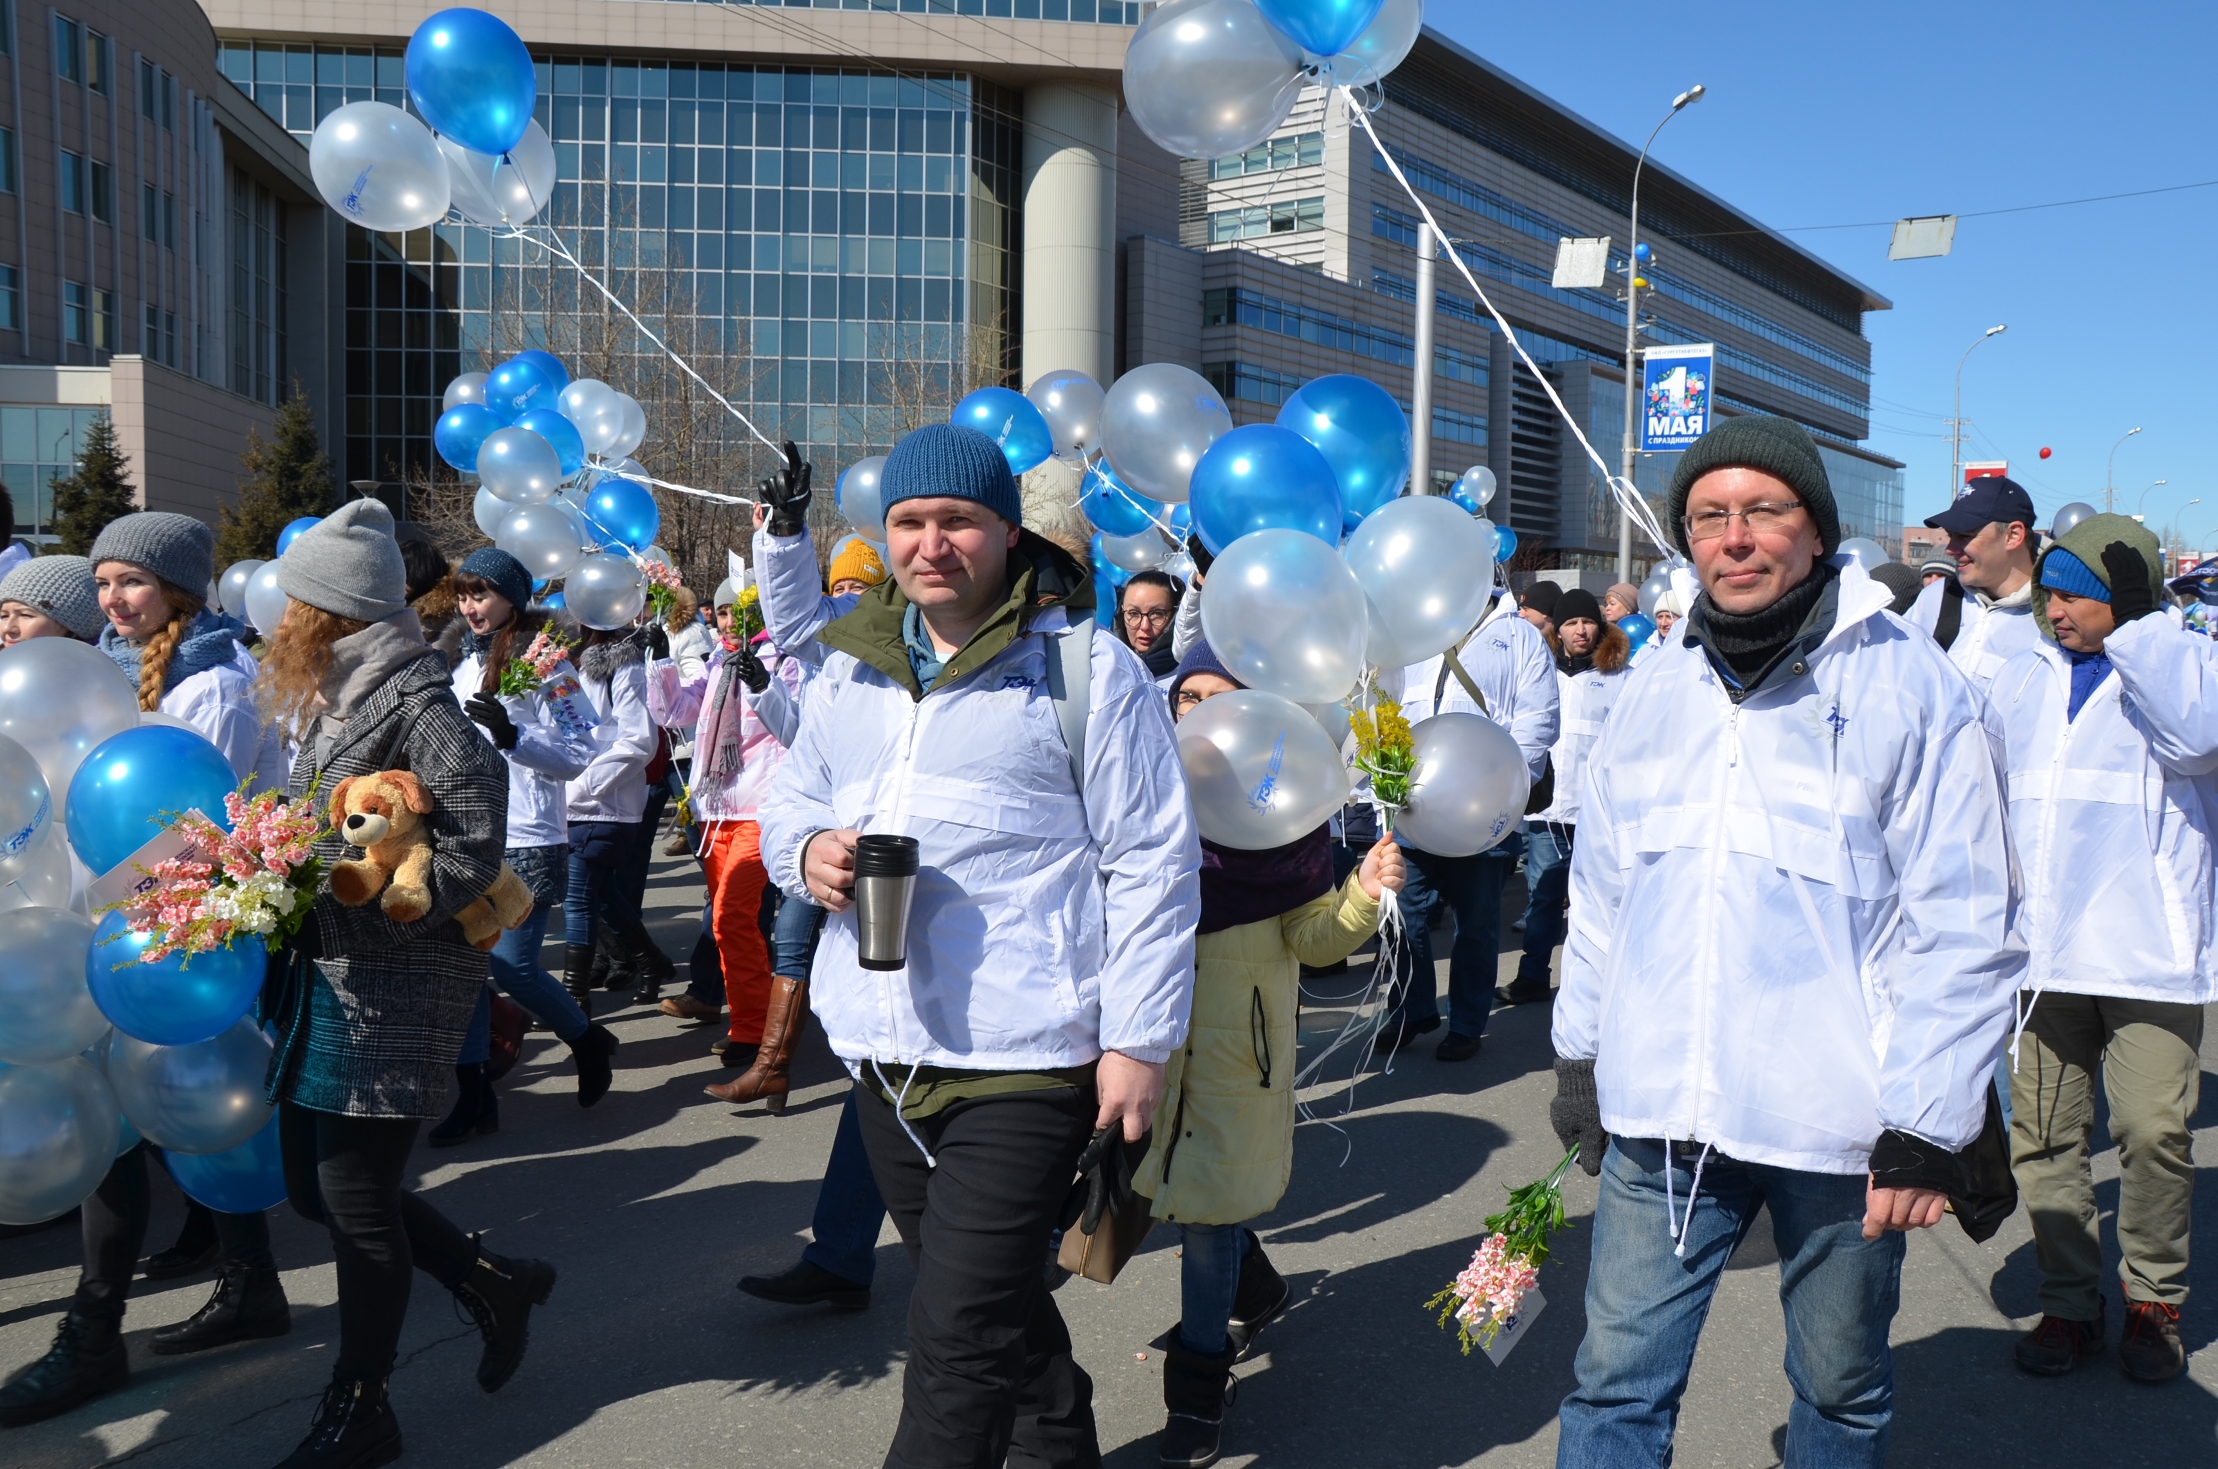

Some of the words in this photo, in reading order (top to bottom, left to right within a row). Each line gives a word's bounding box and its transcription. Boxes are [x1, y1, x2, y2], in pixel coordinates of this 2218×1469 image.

[1659, 366, 1687, 415] 1
[1648, 415, 1703, 436] МАЯ
[1492, 638, 1511, 651] ТЭК
[1256, 771, 1275, 803] ТЭК
[10, 822, 34, 850] ТЭК
